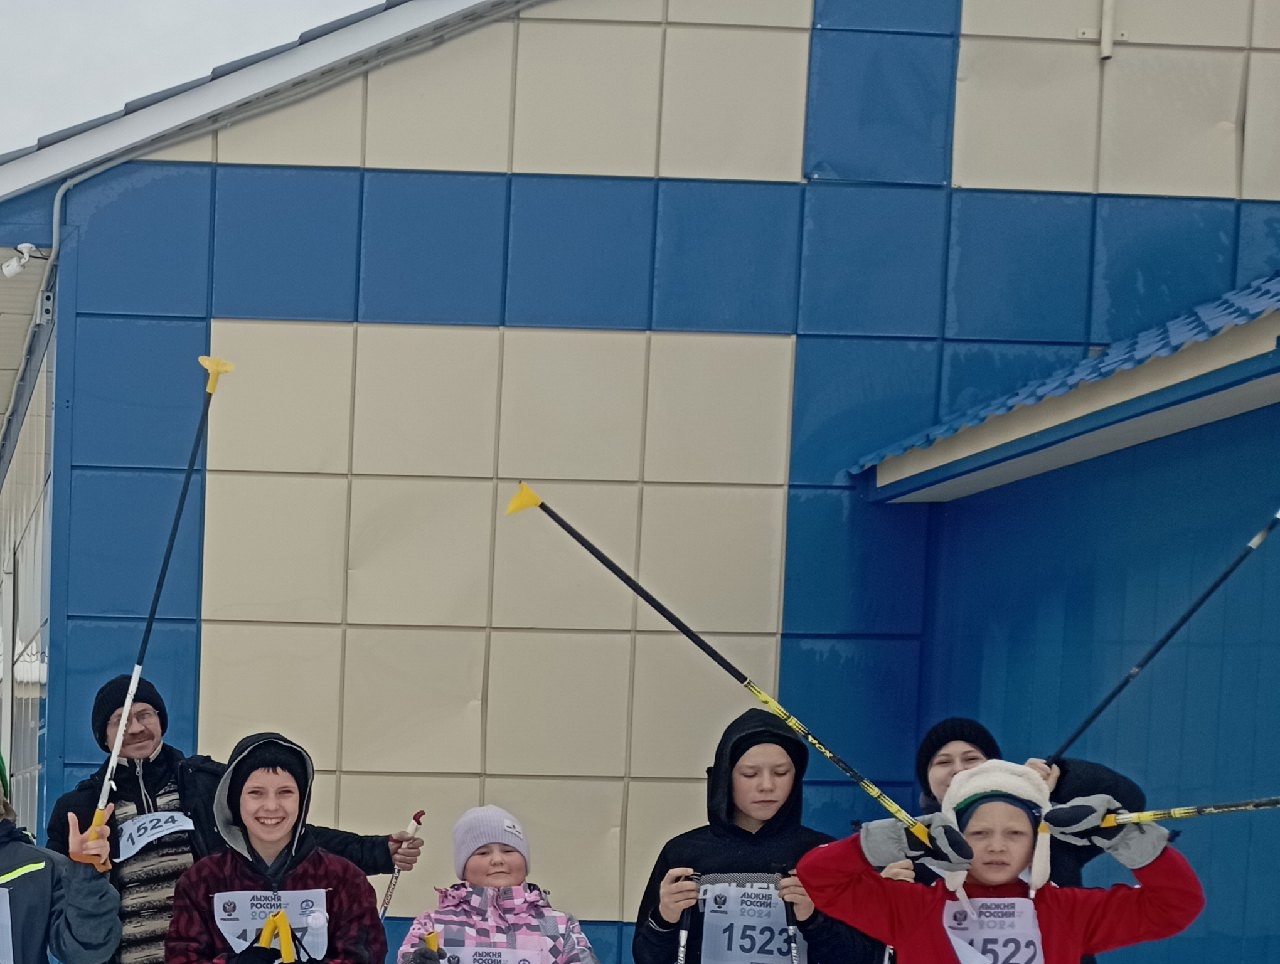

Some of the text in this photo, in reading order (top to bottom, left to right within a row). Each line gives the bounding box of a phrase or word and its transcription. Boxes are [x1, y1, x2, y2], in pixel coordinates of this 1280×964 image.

[126, 815, 179, 846] 1524
[250, 894, 282, 902] ЛЫЖНЯ
[740, 892, 773, 900] ЛЫЖНЯ
[250, 902, 282, 910] РОССИИ
[740, 899, 772, 909] РОССИИ
[738, 908, 772, 919] 2024
[722, 922, 792, 956] 1523
[472, 951, 502, 959] ЛЫЖНЯ
